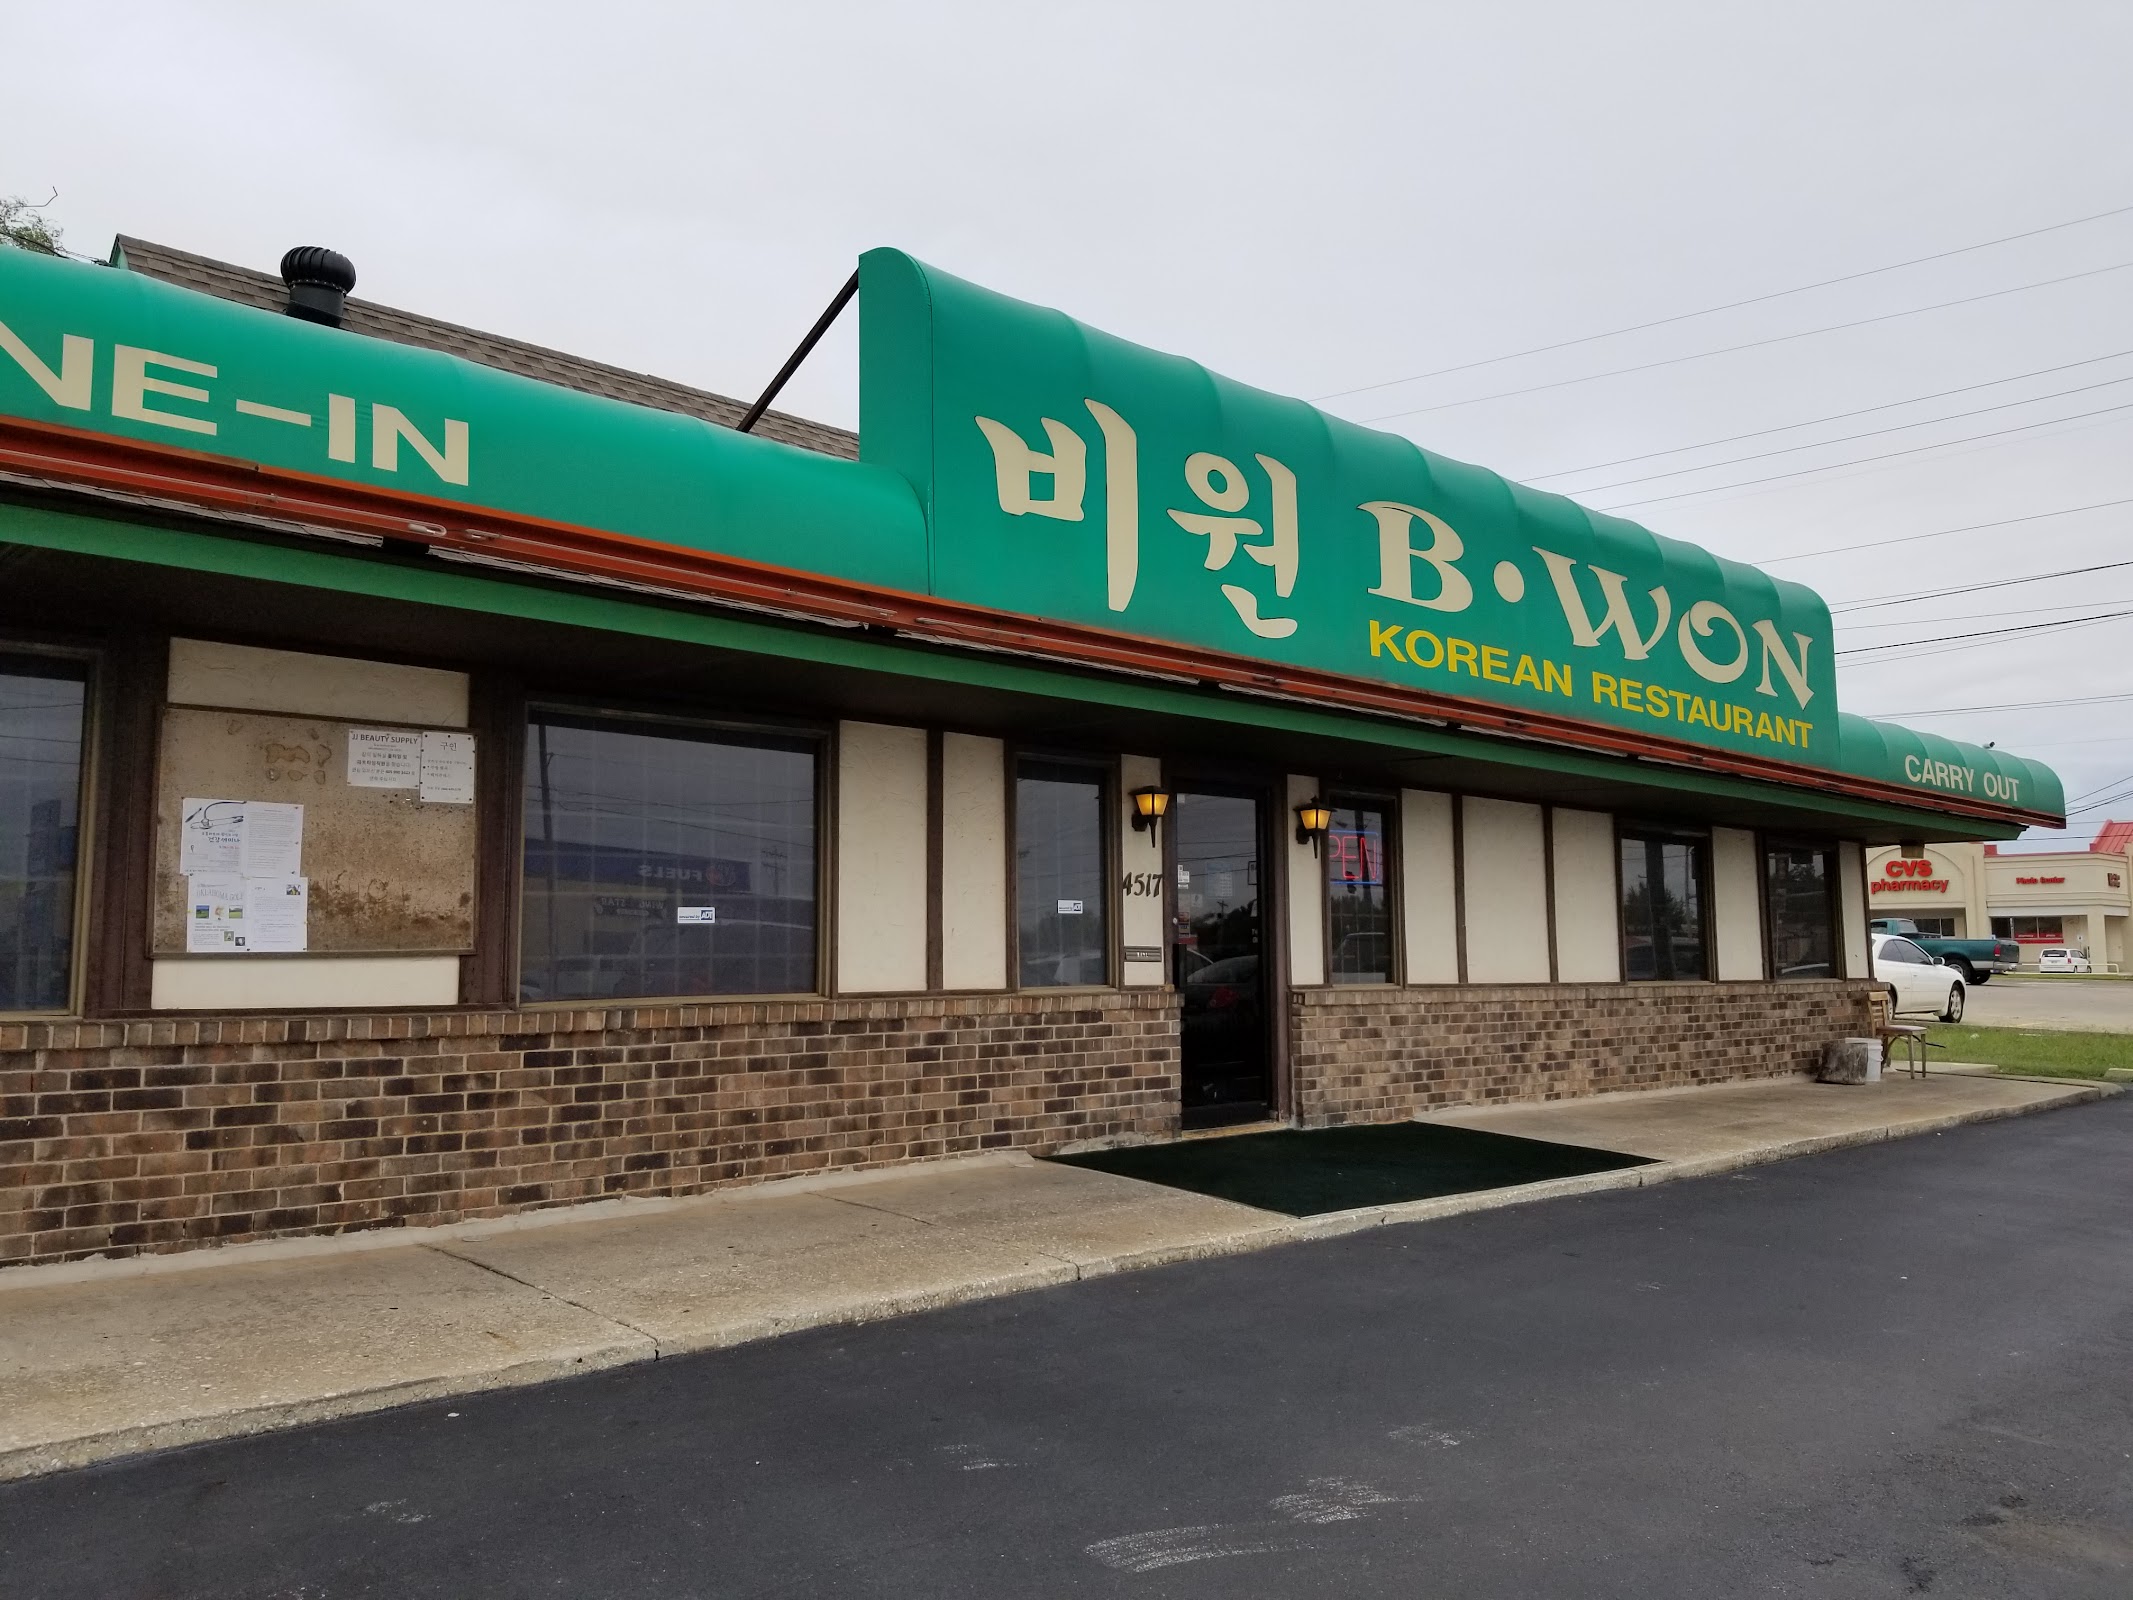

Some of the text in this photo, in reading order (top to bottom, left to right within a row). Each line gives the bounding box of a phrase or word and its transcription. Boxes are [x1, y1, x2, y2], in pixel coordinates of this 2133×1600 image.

[974, 397, 1299, 639] 비원
[1368, 619, 1815, 750] KOREAN RESTAURANT
[352, 733, 418, 745] JJ BEAUTY SUPPLY
[440, 741, 457, 751] 구인
[1904, 754, 2020, 802] CARRY OUT
[1329, 835, 1377, 880] PEN
[1885, 859, 1933, 878] CVS
[1122, 871, 1164, 898] 4517
[1870, 877, 1950, 895] pharmacy
[700, 910, 713, 920] ADT
